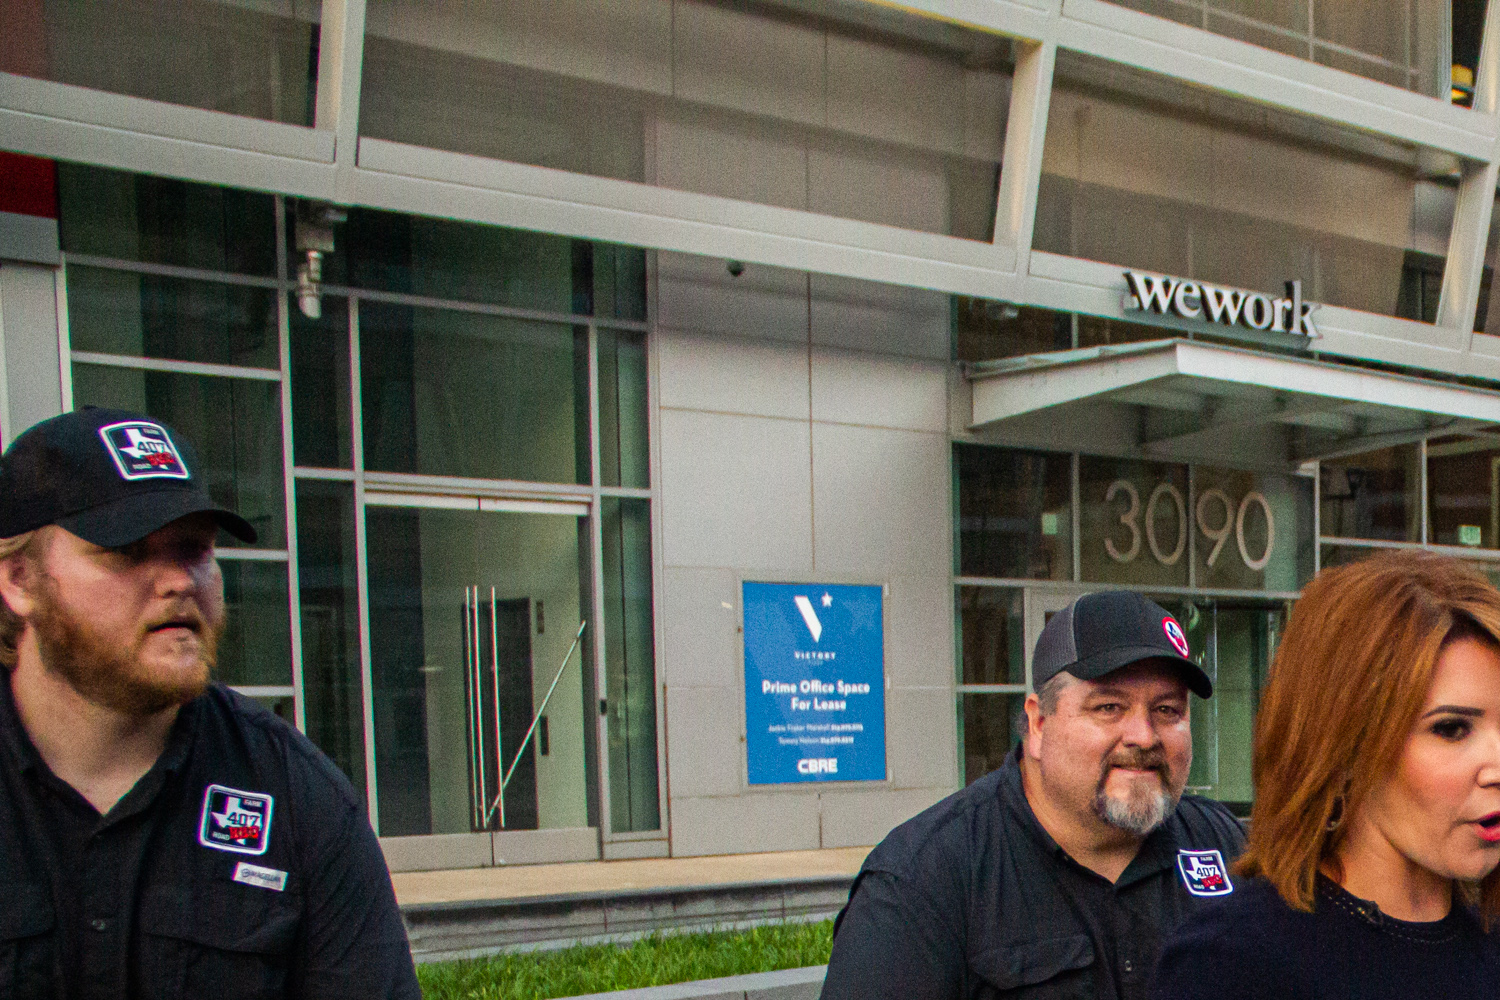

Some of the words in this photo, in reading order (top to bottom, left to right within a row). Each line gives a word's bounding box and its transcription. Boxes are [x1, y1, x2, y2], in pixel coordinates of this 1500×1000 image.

[1122, 269, 1324, 339] wework
[1104, 479, 1276, 571] 3090
[762, 680, 797, 694] Prime
[800, 680, 835, 695] Office
[837, 680, 870, 697] Space
[791, 697, 811, 711] For
[814, 697, 847, 711] Lease
[797, 758, 838, 774] CBRE
[227, 811, 260, 827] 407
[1196, 867, 1216, 877] 407
